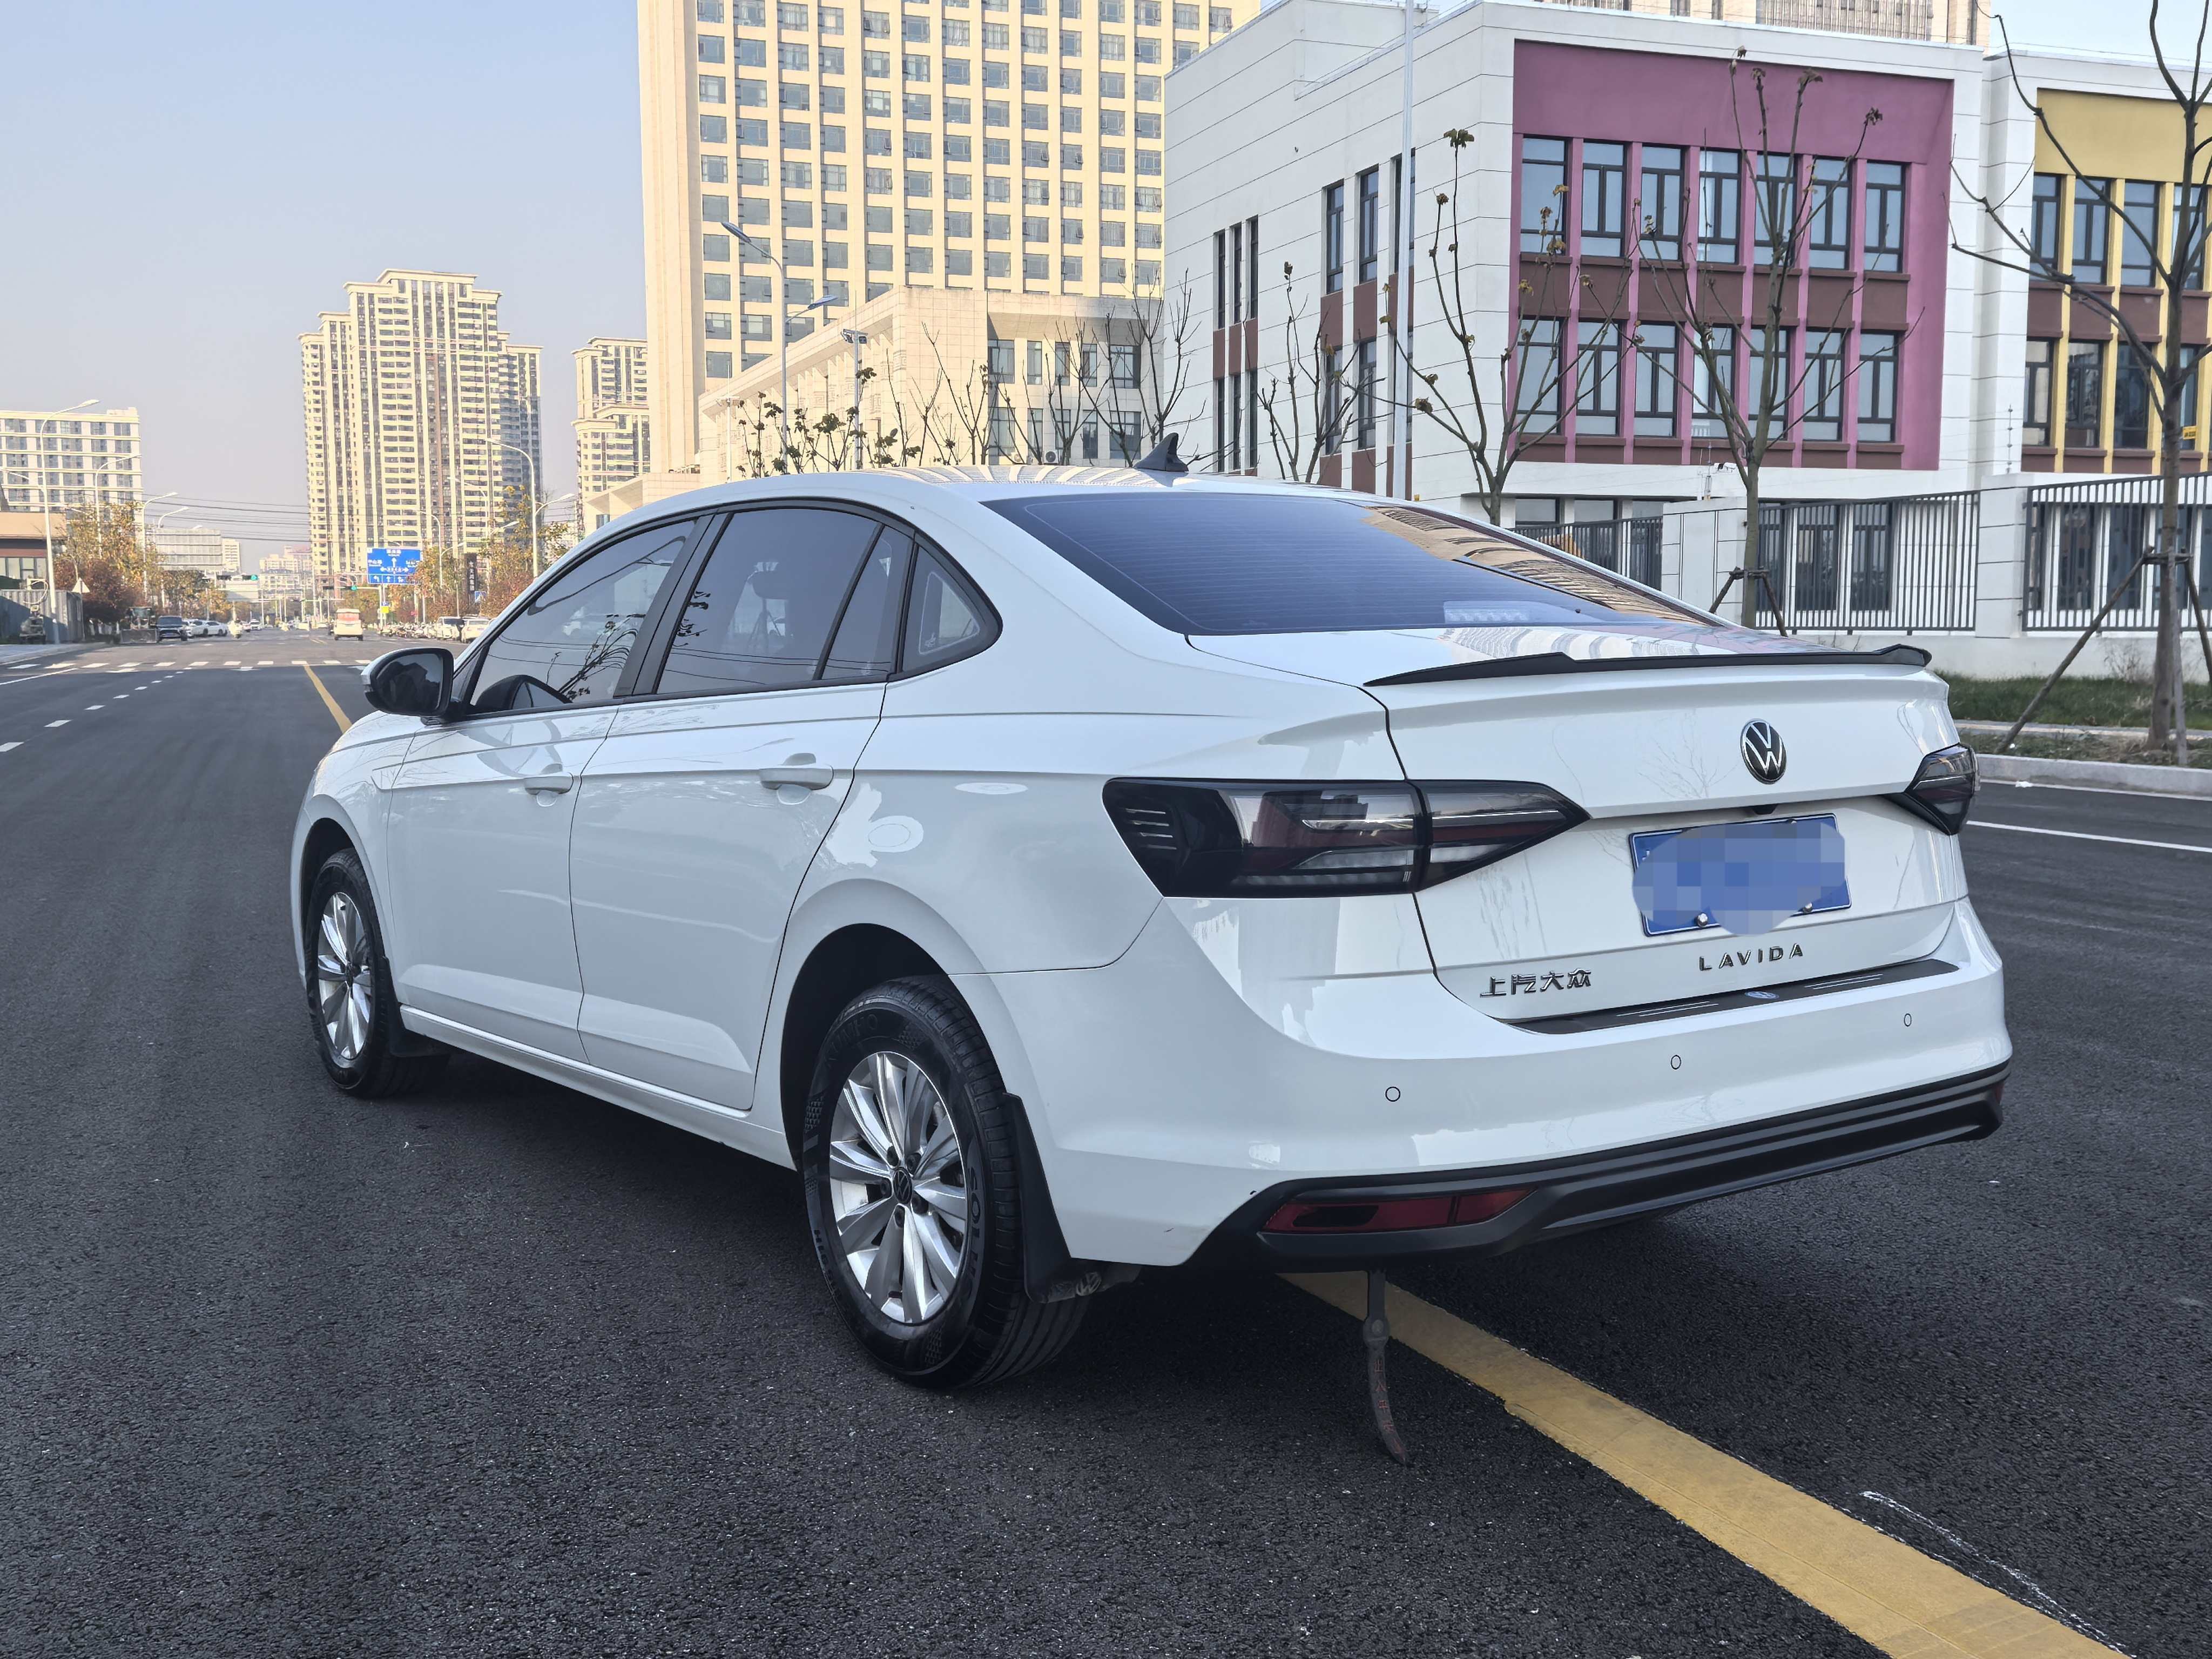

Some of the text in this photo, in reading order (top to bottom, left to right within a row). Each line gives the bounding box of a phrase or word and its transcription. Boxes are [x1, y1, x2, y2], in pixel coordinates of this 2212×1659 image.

[1700, 942, 1804, 972] LAVIDA
[1480, 968, 1592, 997] 上汽大众
